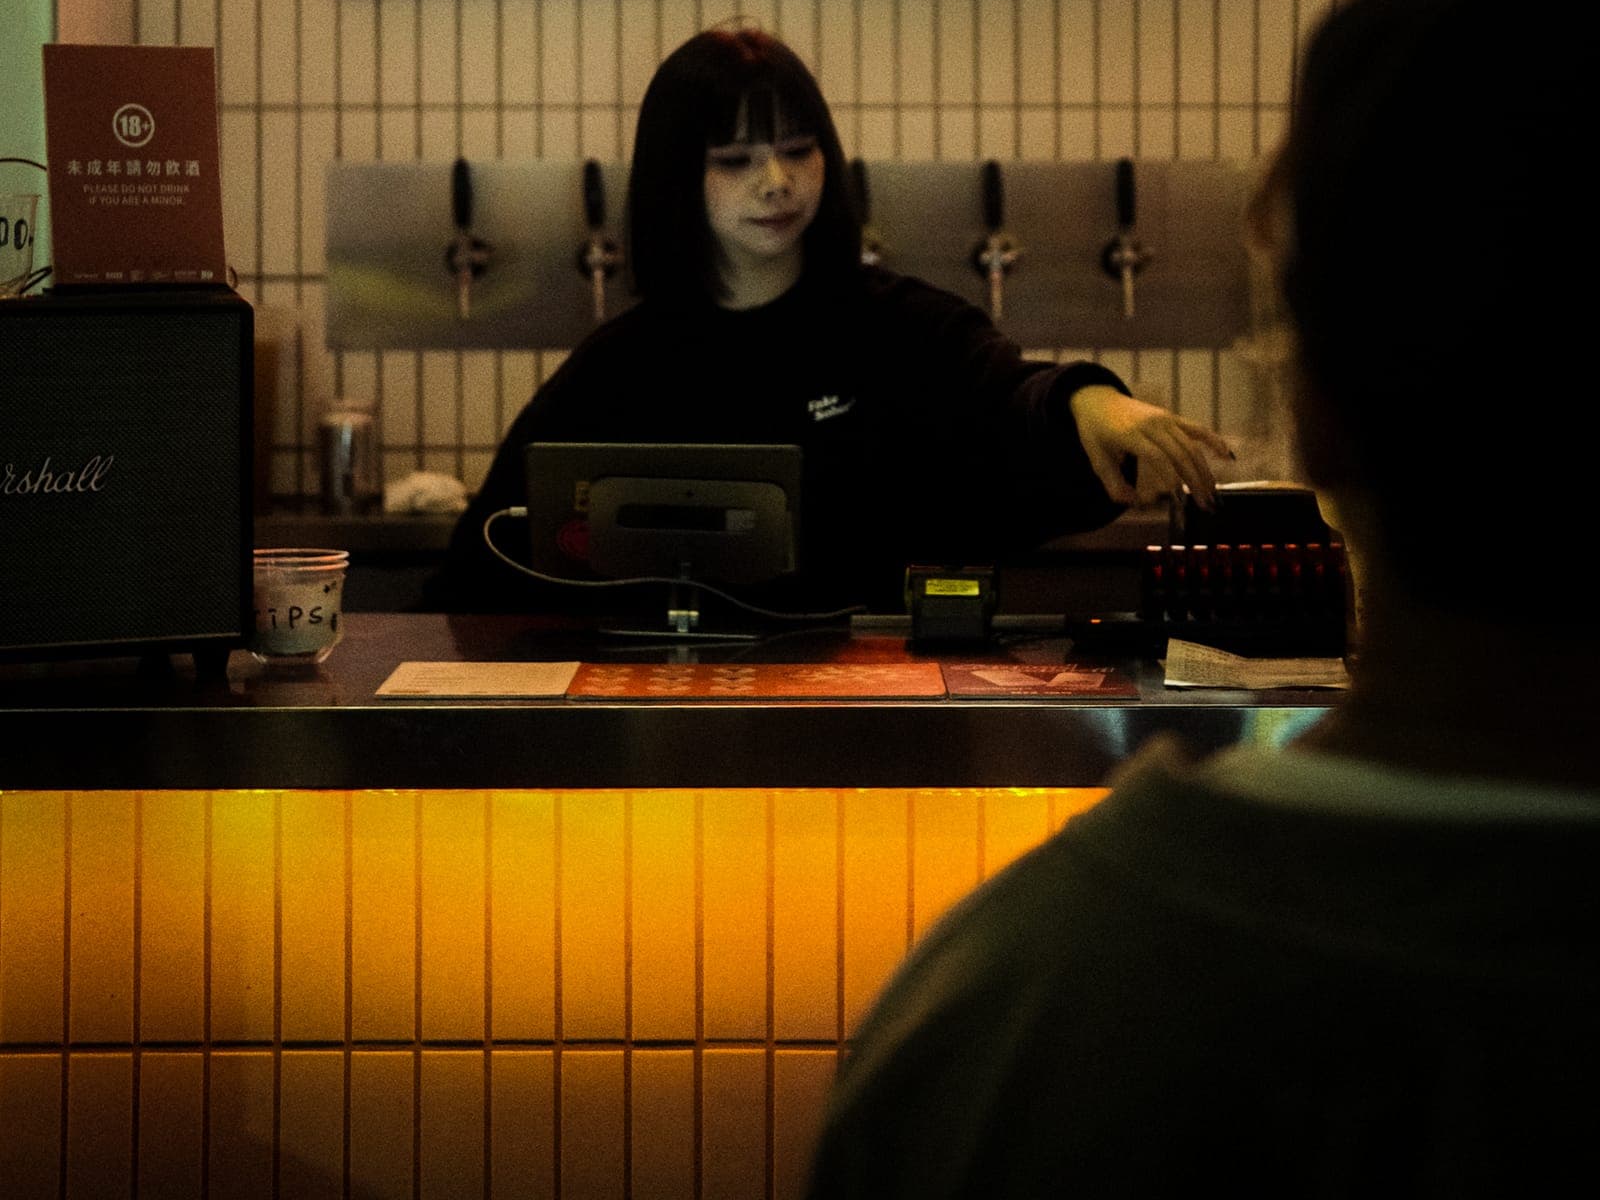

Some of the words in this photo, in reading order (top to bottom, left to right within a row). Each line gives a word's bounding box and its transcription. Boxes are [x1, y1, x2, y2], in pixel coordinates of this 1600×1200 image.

[119, 115, 151, 137] 18+
[83, 183, 119, 193] PLEASE
[121, 183, 136, 193] DO
[138, 183, 157, 193] NOT
[160, 183, 190, 193] DRINK
[101, 195, 120, 205] YOU
[122, 195, 139, 205] ARE
